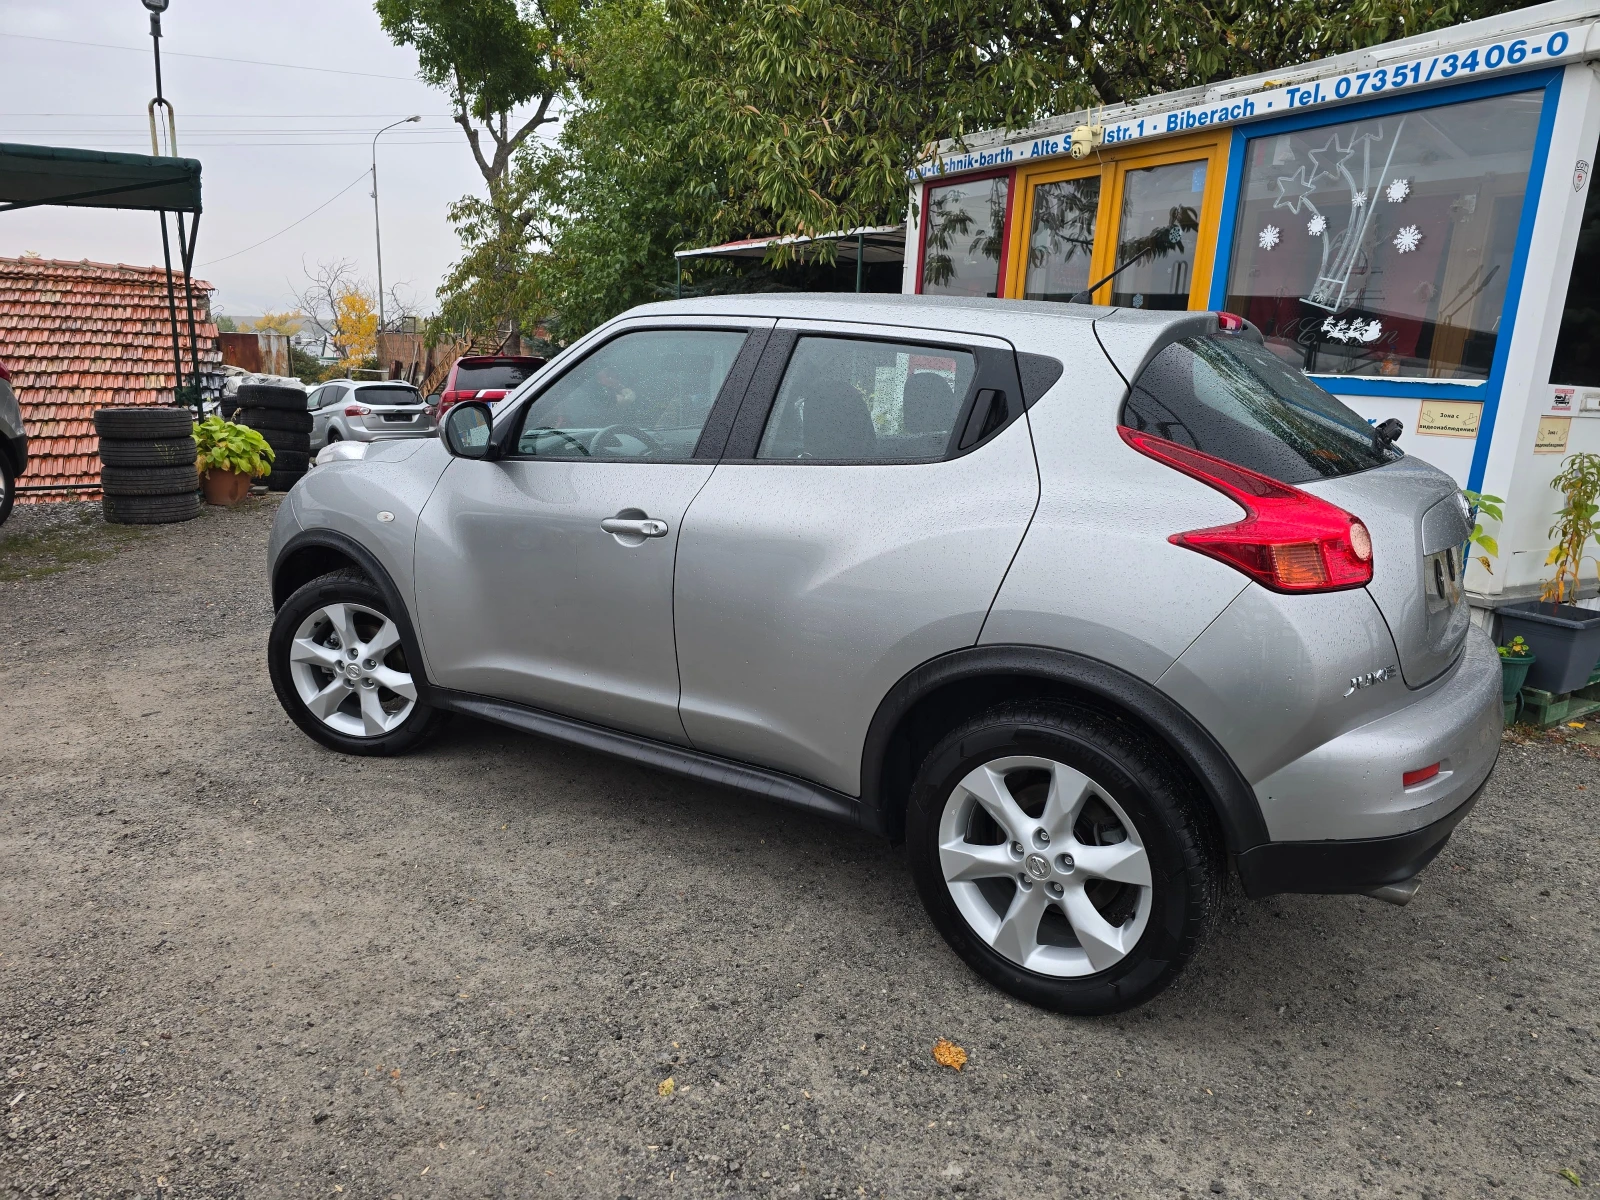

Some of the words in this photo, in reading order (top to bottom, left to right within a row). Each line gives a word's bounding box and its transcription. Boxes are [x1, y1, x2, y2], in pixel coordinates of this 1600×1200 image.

[1030, 140, 1059, 158] Alte
[1062, 126, 1133, 153] Slstr.
[1166, 97, 1255, 132] Biberach
[1286, 84, 1326, 108] Tel.
[1334, 31, 1569, 99] 07351/3406-0
[1419, 423, 1477, 433] видеонаблюдение!
[1343, 665, 1397, 698] JUKE
